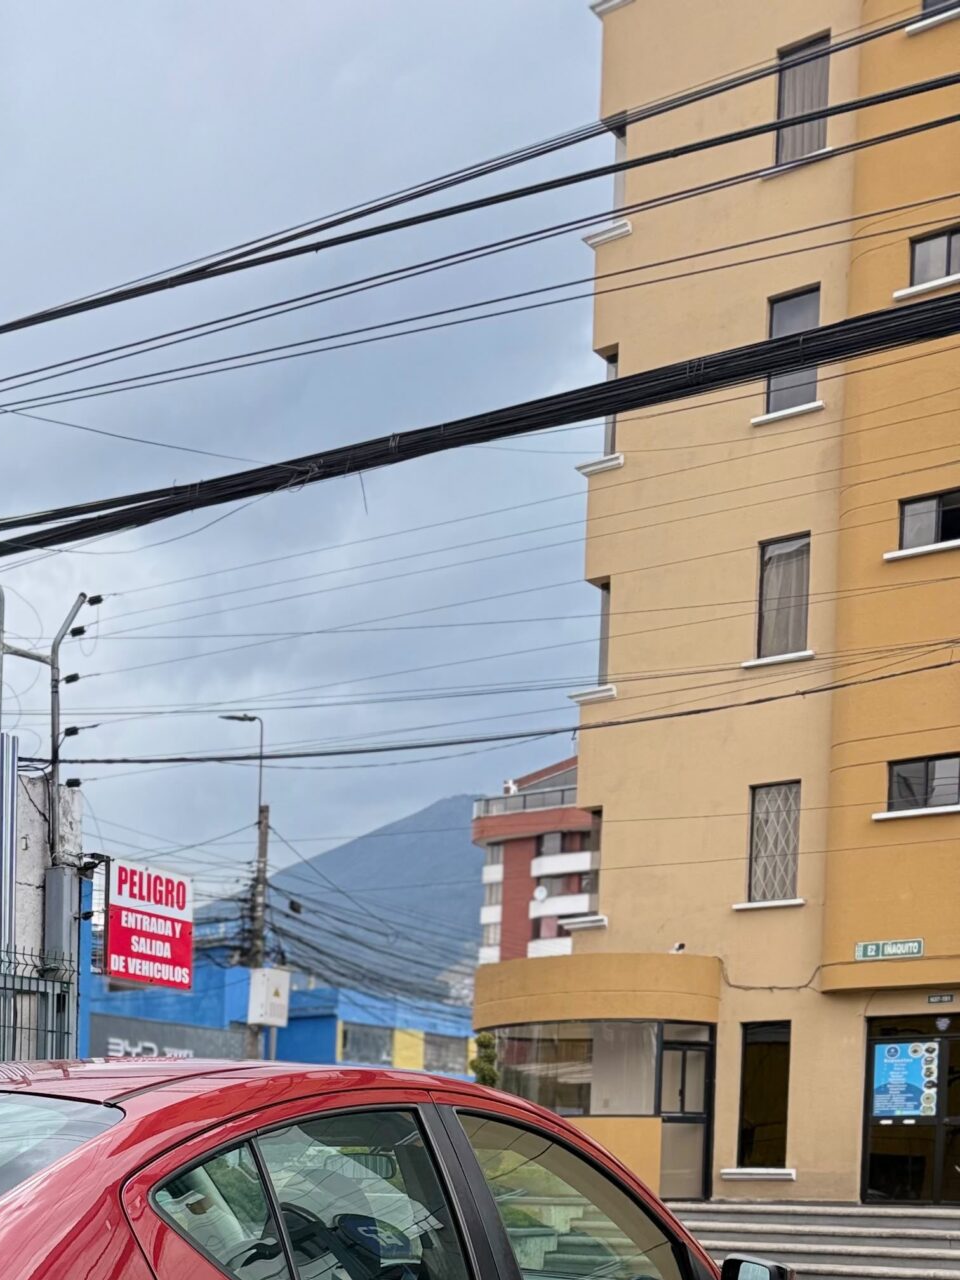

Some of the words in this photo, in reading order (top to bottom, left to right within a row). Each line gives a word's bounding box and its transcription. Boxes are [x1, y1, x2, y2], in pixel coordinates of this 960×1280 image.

[117, 865, 187, 911] PELIGRO
[121, 911, 172, 936] ENTRADA
[174, 923, 182, 939] Y
[131, 936, 172, 959] SALIDA
[883, 942, 919, 955] IÑAQUITO
[110, 954, 126, 973] DE
[127, 959, 190, 984] VEHICULOS
